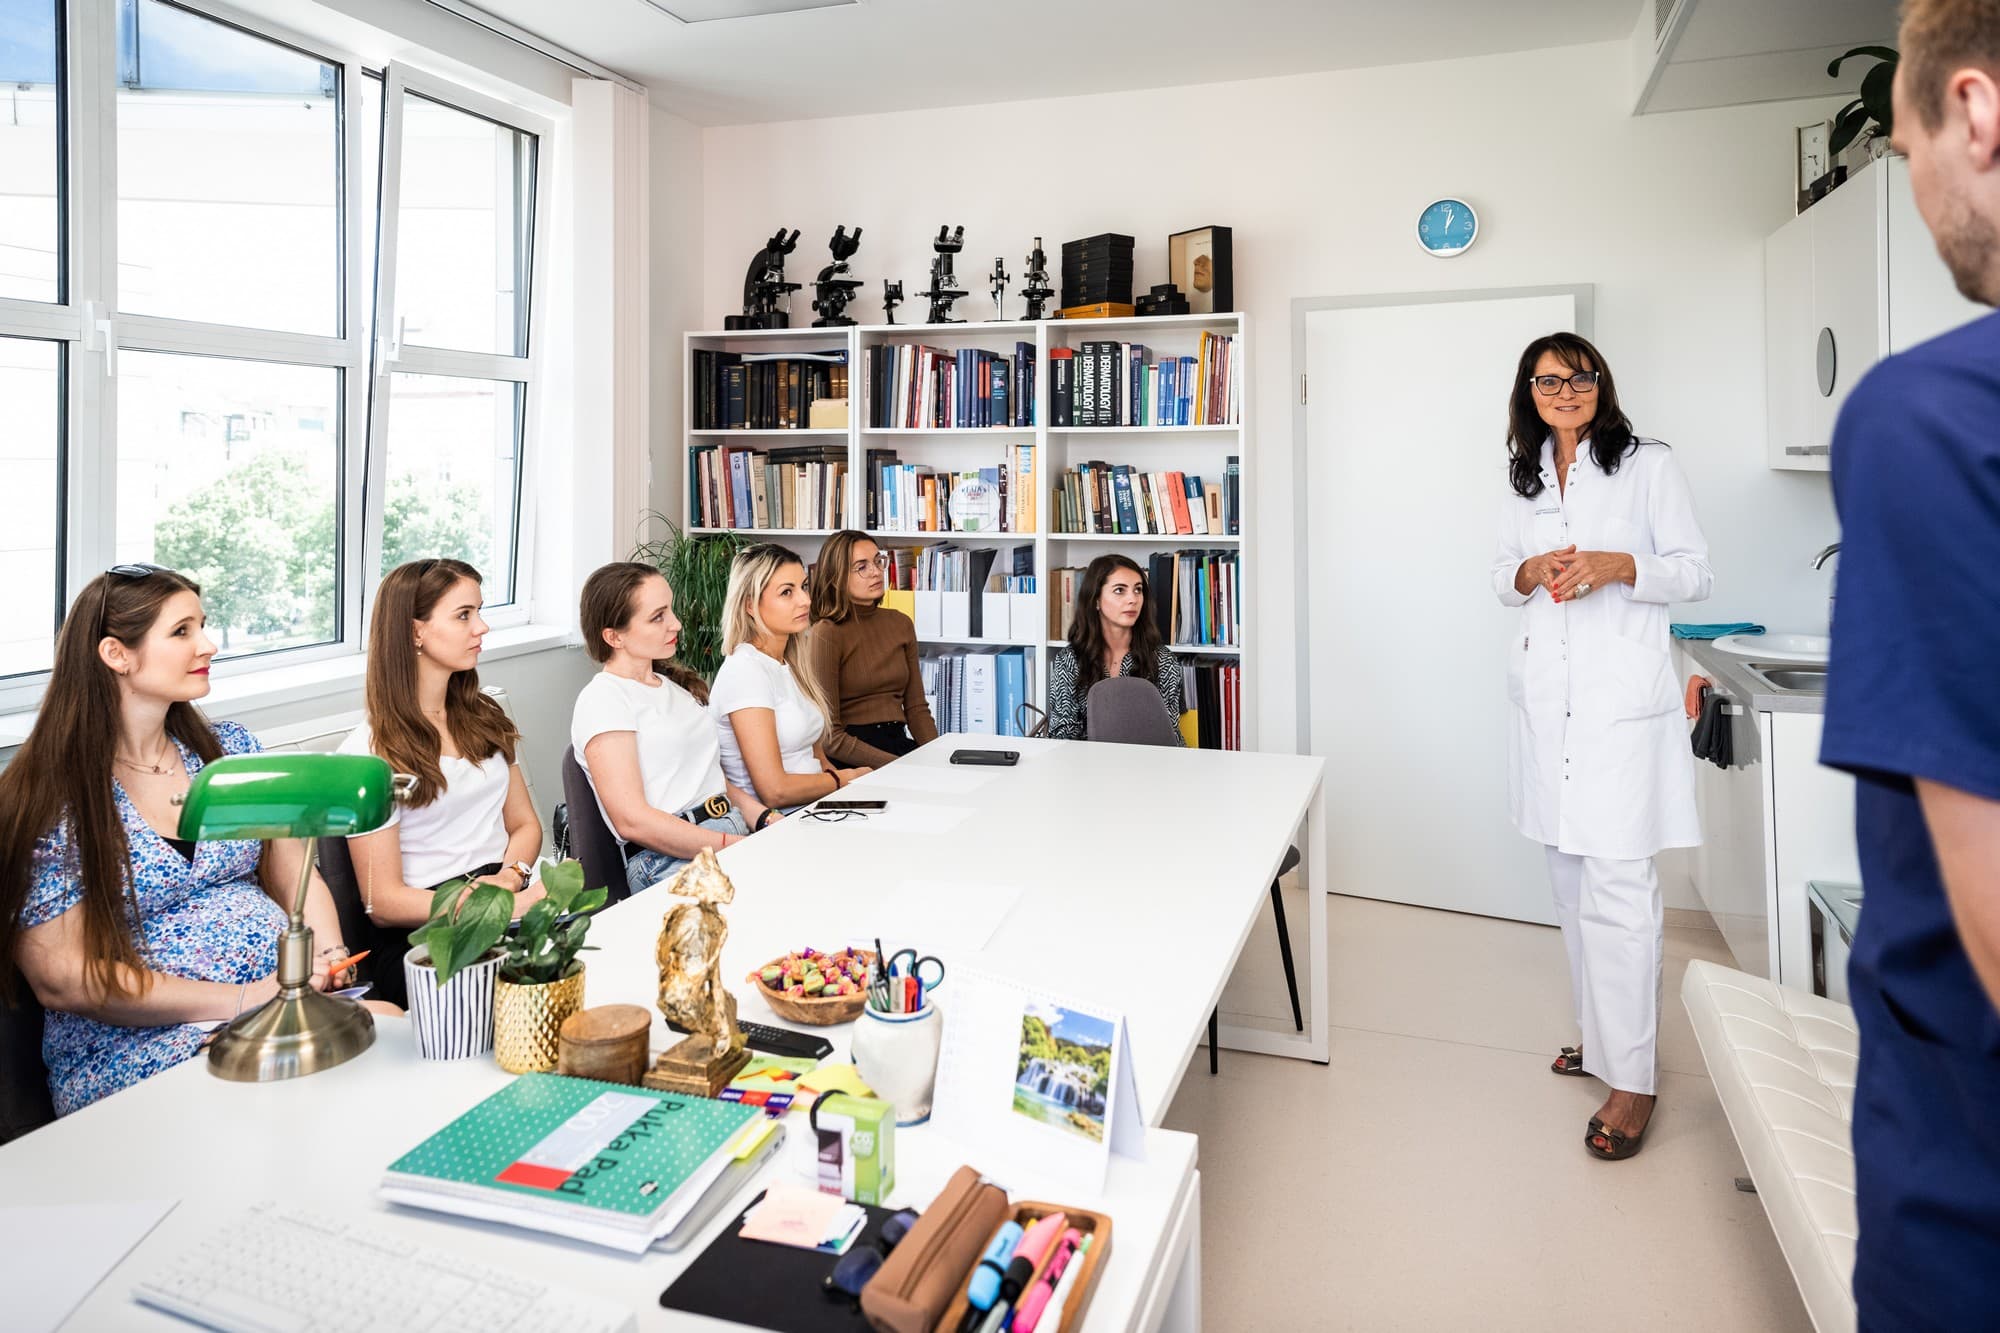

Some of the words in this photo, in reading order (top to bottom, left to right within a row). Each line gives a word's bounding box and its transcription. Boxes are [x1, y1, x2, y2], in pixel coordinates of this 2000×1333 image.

[1441, 203, 1451, 212] 12
[1463, 221, 1472, 230] 3
[1082, 355, 1095, 411] DERMATOLOGY
[1099, 355, 1112, 411] DERMATOLOGY
[605, 1099, 686, 1152] Pukka
[558, 1156, 619, 1196] Pad
